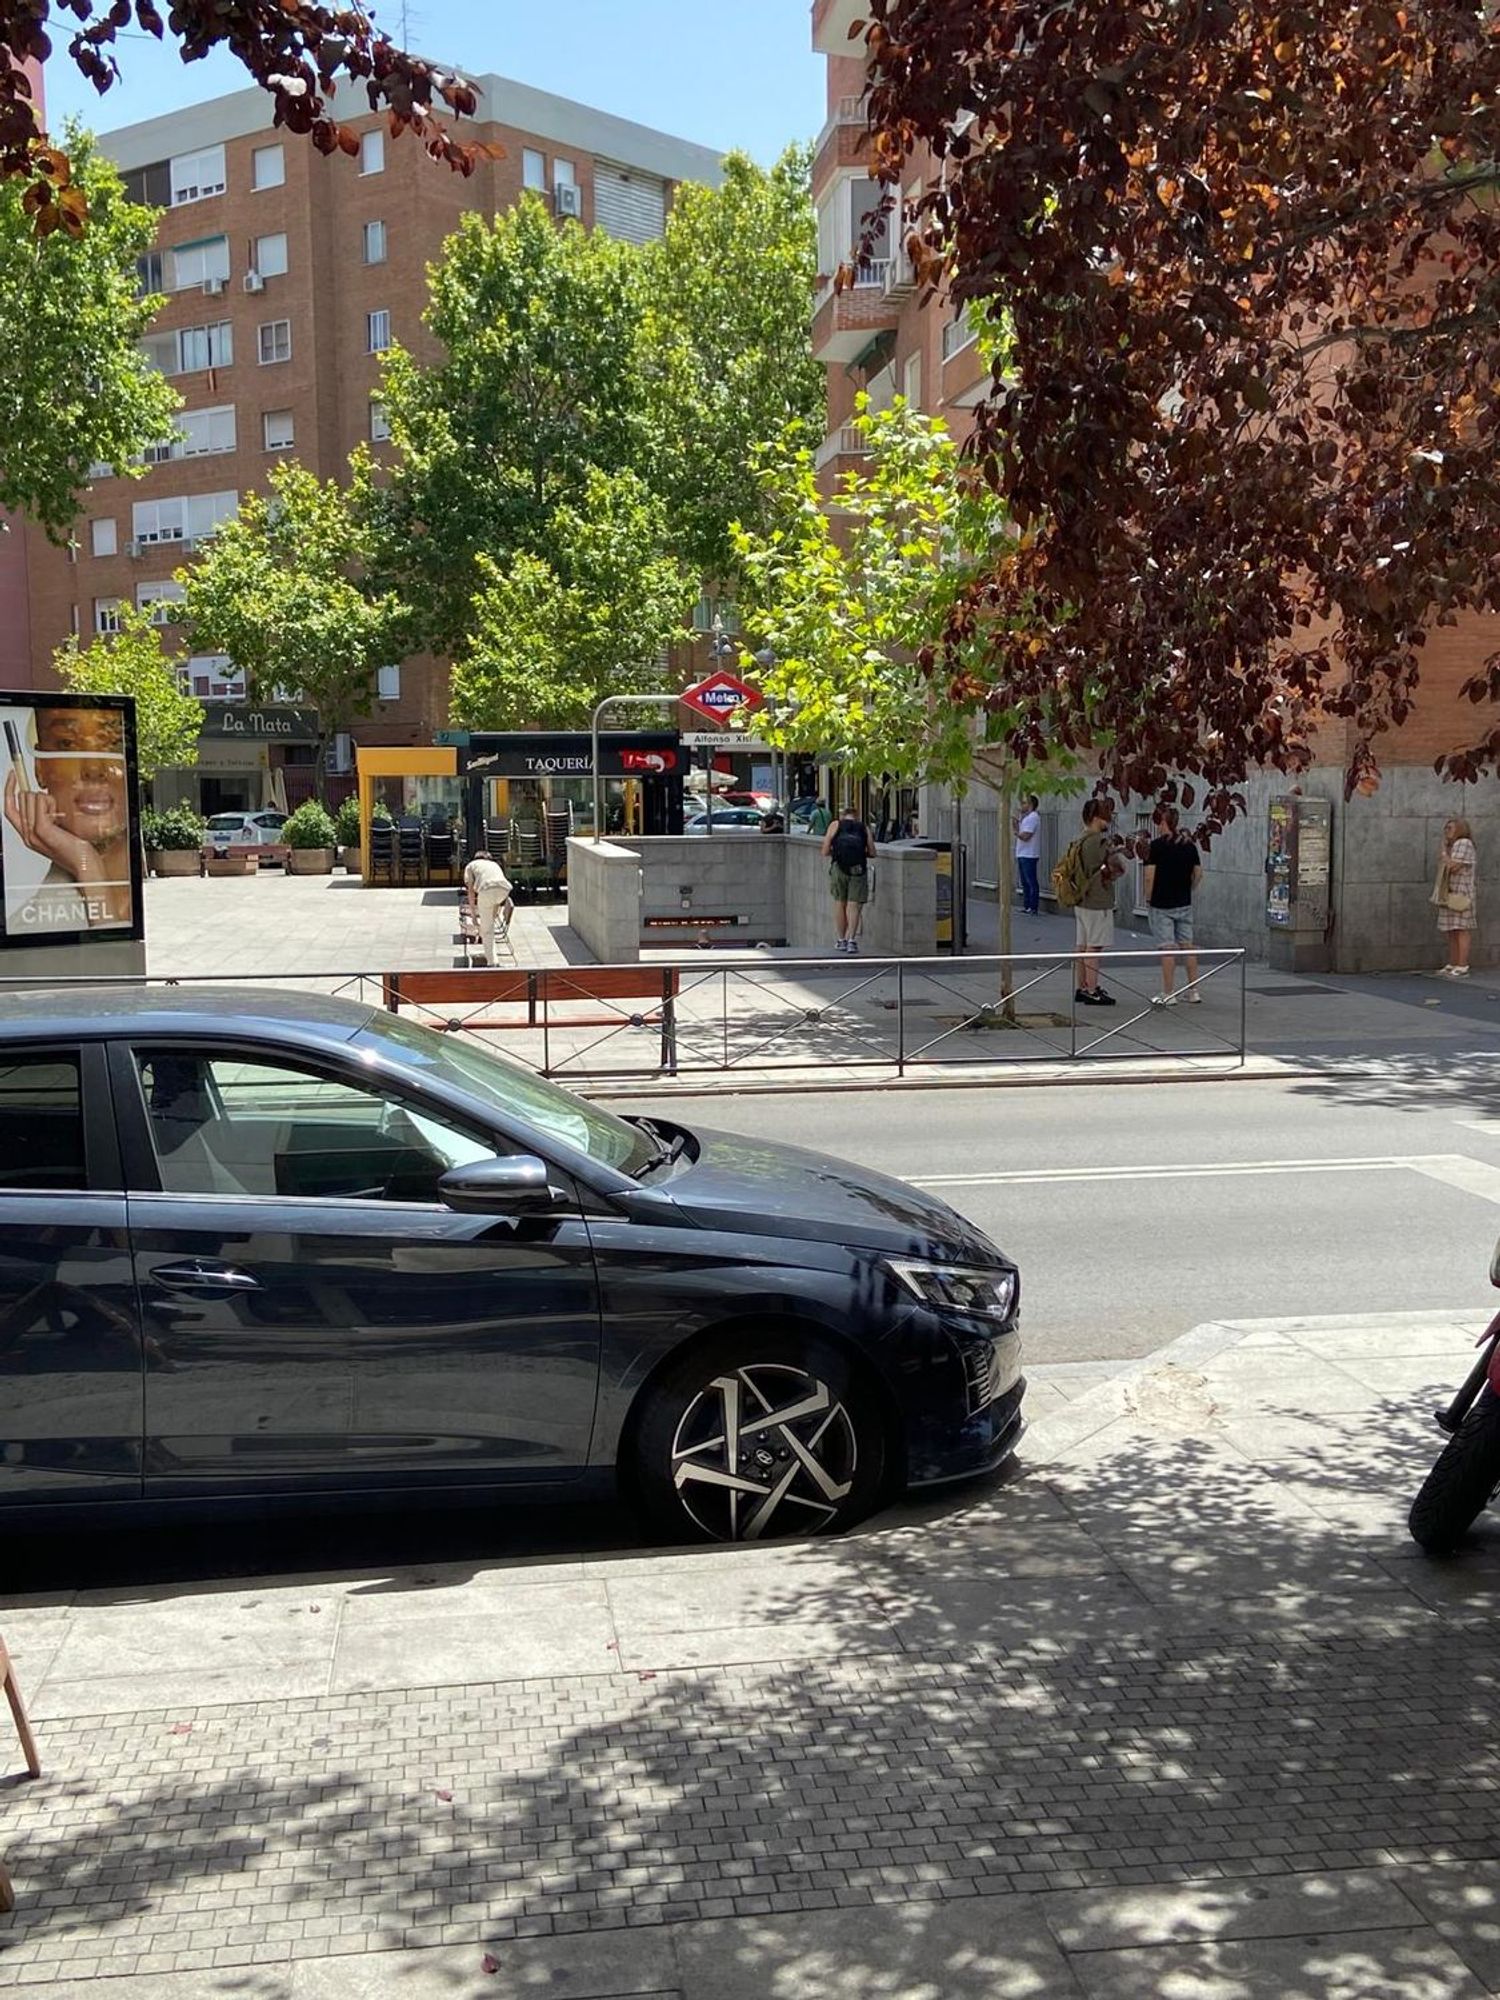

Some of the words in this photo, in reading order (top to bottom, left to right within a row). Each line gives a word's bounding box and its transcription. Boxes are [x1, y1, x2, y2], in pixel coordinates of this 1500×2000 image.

[222, 712, 245, 732] La
[249, 712, 292, 733] Nata
[694, 734, 731, 743] Alfonso
[22, 902, 113, 923] CHANEL
